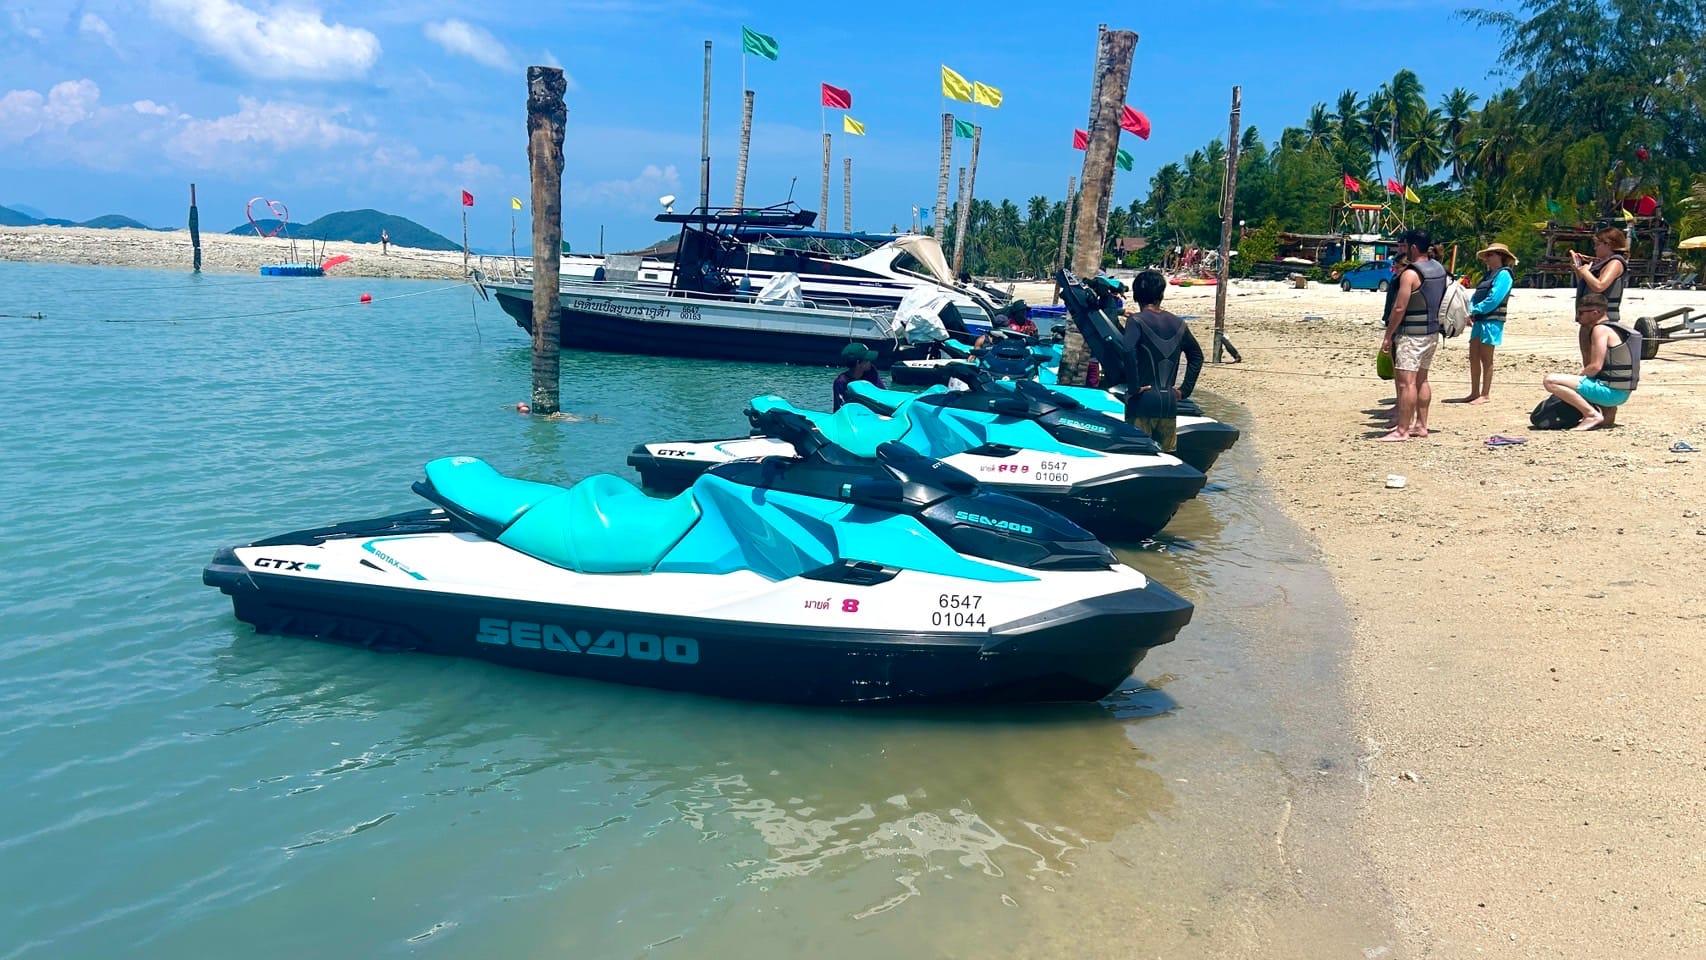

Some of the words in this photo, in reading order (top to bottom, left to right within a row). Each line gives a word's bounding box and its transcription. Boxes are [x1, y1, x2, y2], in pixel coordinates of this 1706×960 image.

[657, 449, 686, 457] GTX
[1041, 460, 1067, 470] 6547
[1035, 471, 1069, 482] 01060
[254, 557, 305, 572] GTX
[375, 549, 400, 568] ROTAX
[841, 598, 860, 613] 8
[939, 593, 982, 609] 6547
[931, 611, 986, 627] 01044
